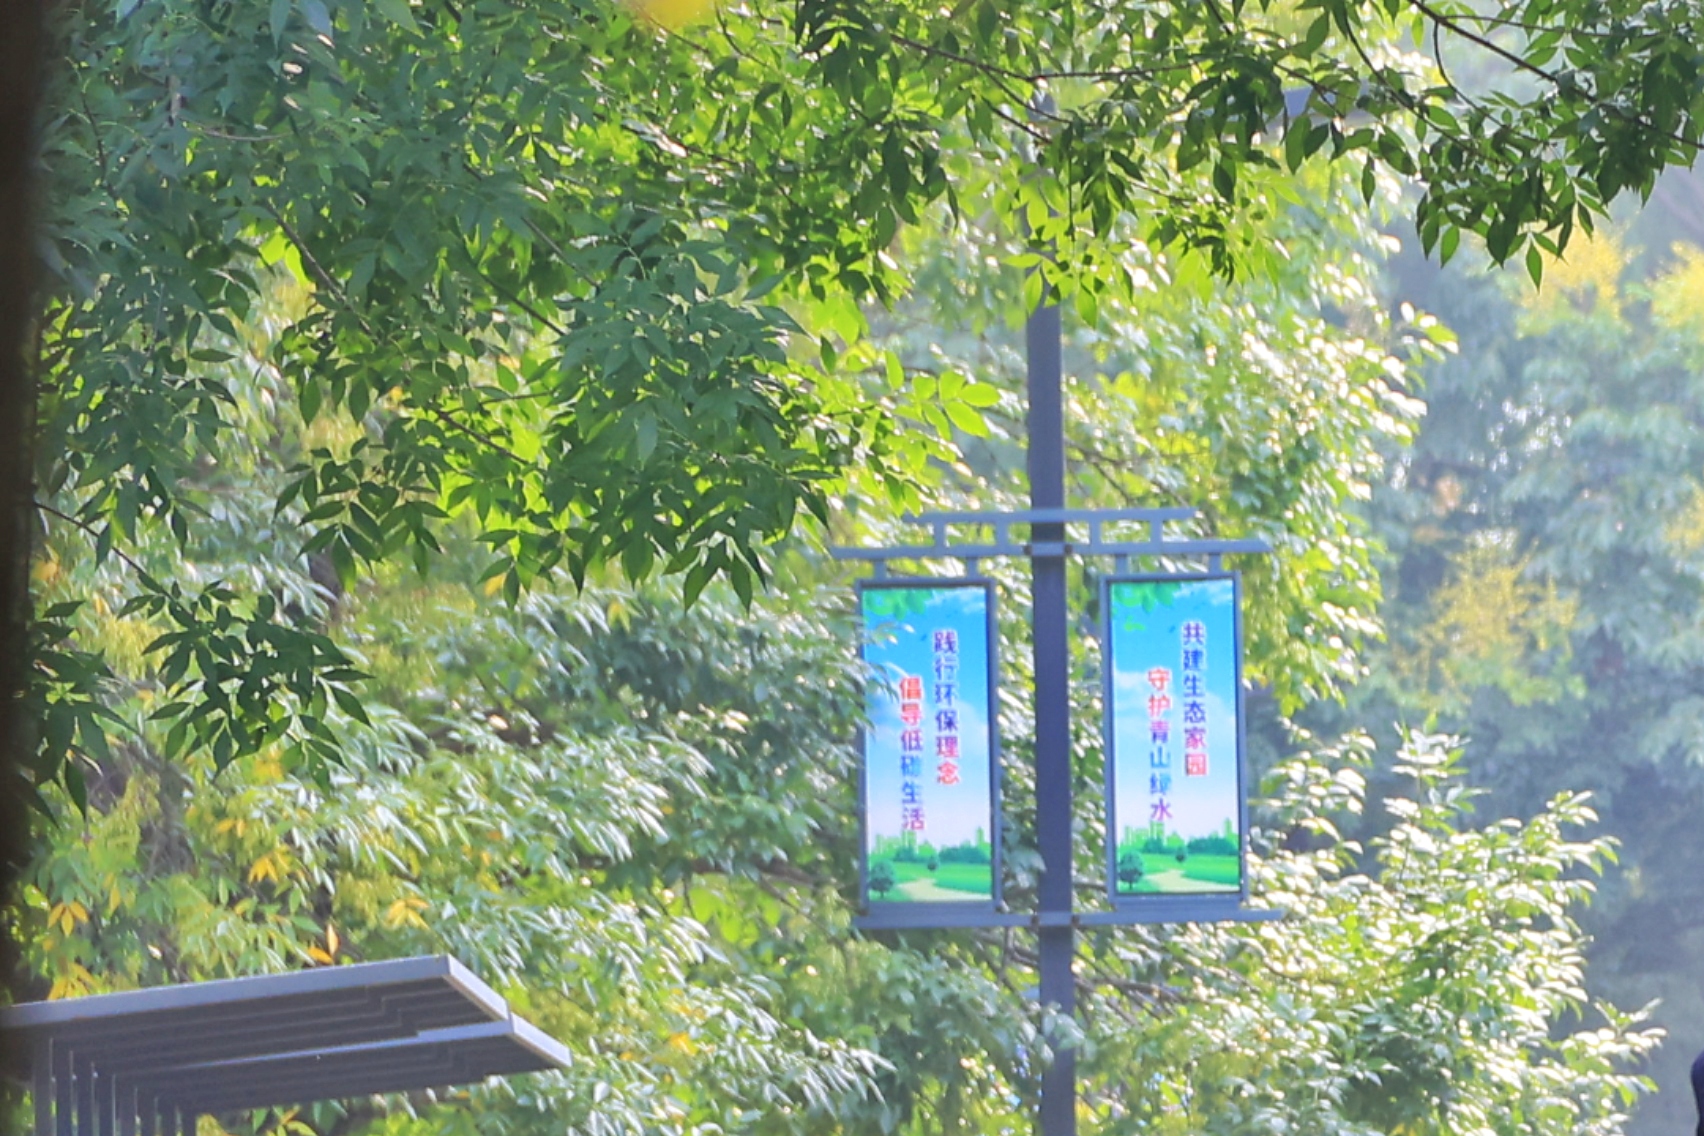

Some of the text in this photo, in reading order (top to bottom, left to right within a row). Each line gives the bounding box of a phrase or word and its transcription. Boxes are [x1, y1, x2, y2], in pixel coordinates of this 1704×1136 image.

[933, 630, 960, 785] 践行环保理念
[1147, 667, 1173, 822] 守护青山绿水
[1182, 622, 1208, 777] 共建生态家园
